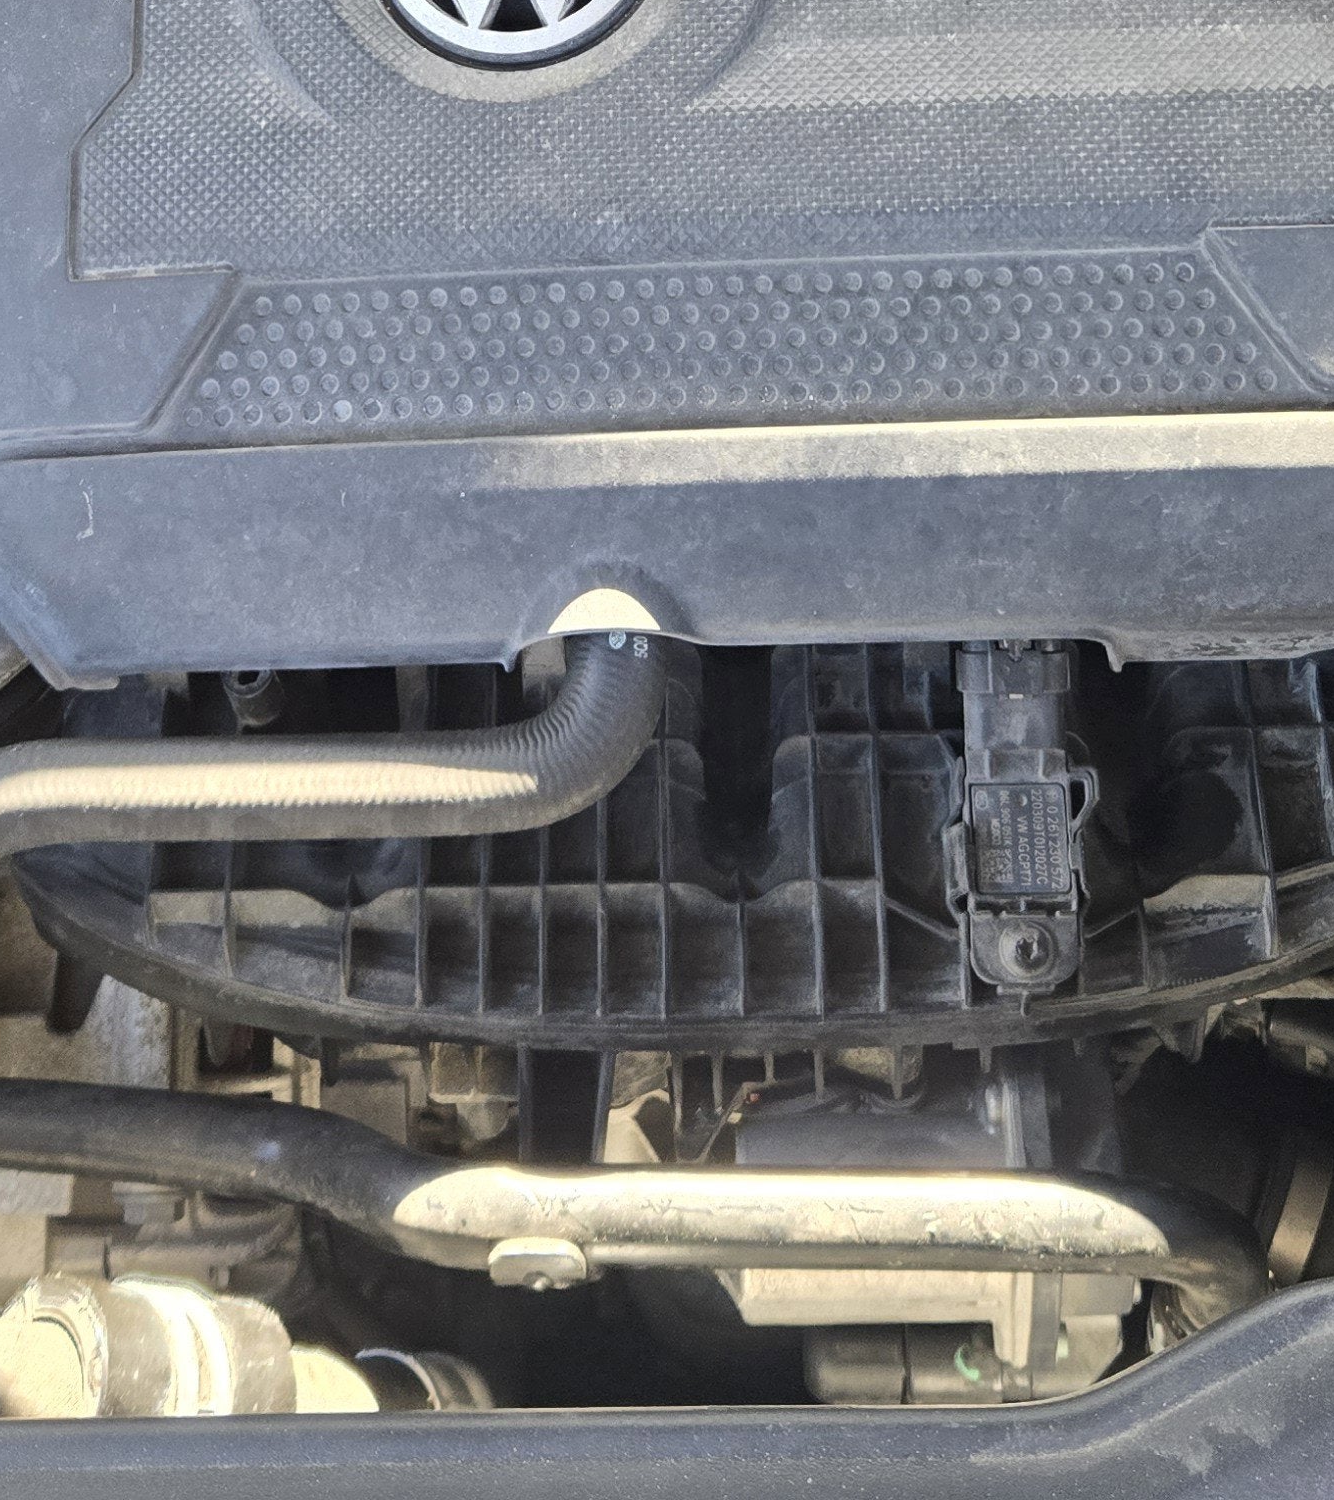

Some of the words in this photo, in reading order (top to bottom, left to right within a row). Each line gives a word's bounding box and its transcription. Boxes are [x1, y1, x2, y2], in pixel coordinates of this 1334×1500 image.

[1047, 805, 1058, 814] 0
[1017, 815, 1029, 833] VW
[1049, 841, 1062, 864] 230
[1051, 867, 1064, 890] 572
